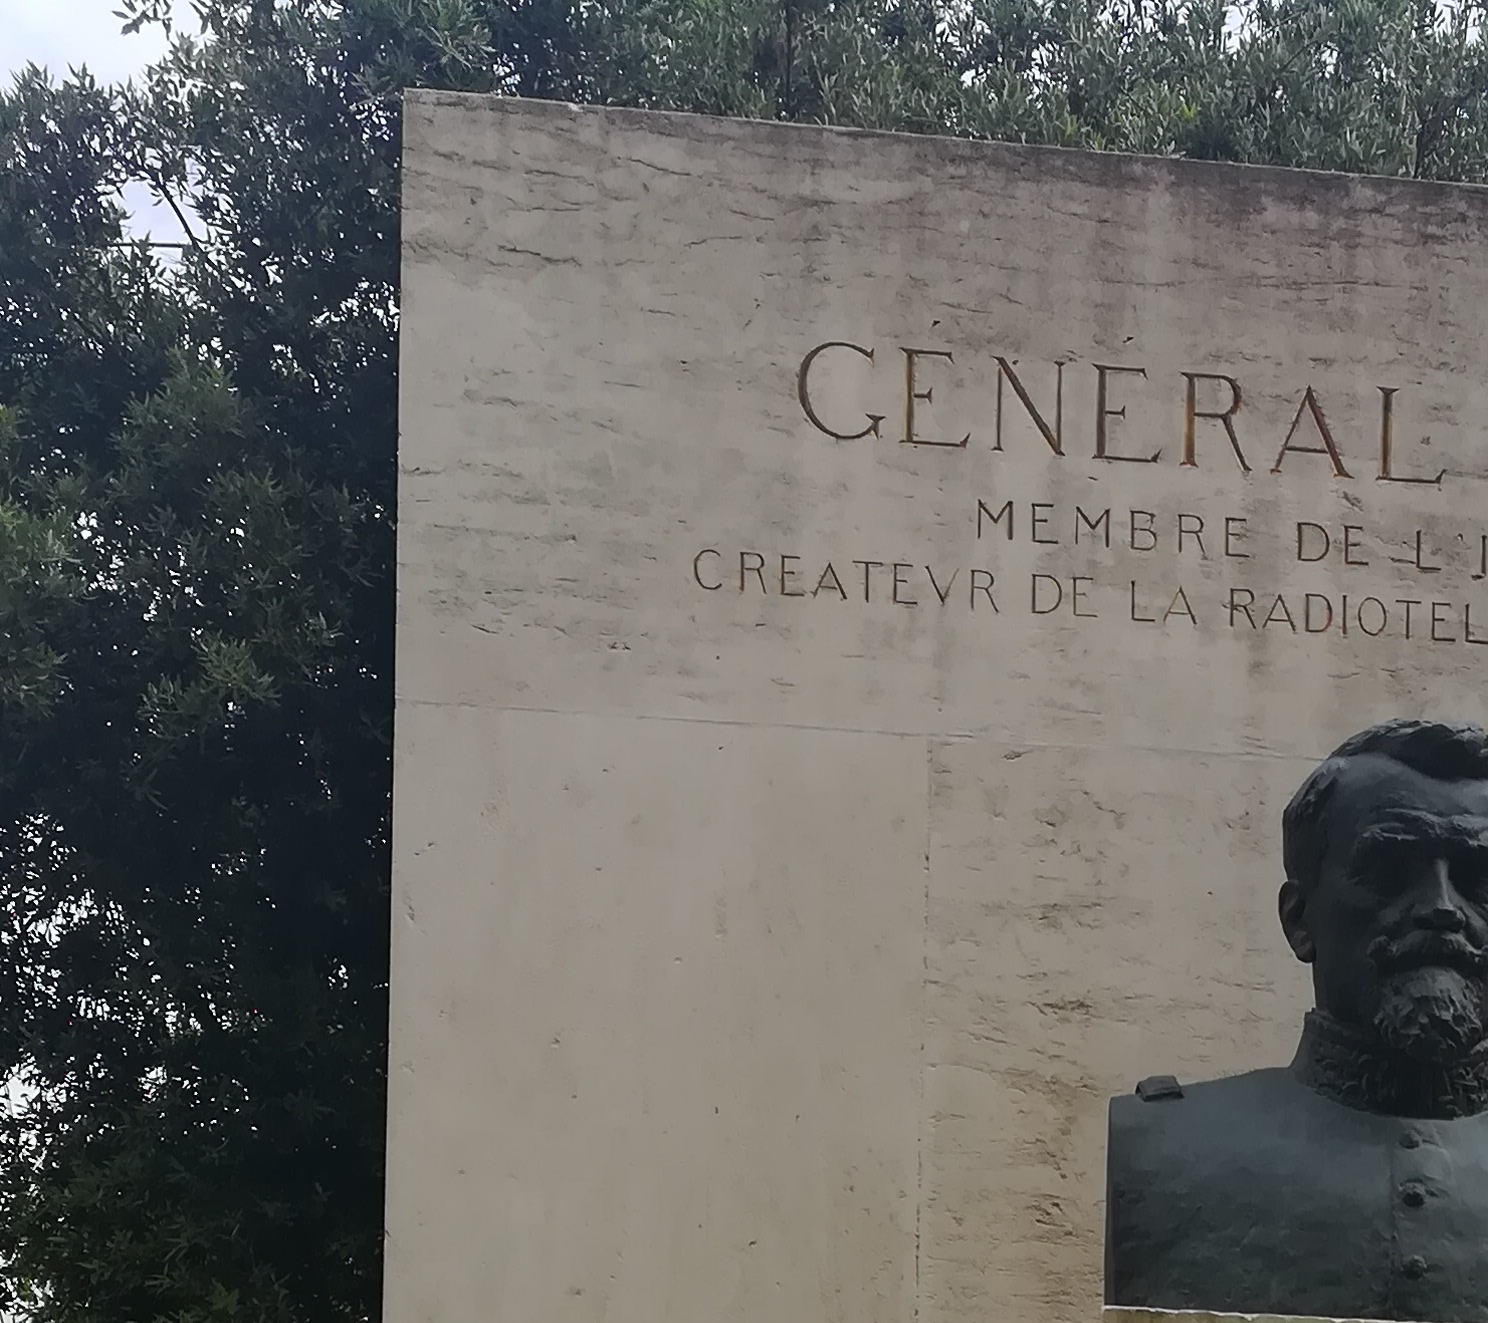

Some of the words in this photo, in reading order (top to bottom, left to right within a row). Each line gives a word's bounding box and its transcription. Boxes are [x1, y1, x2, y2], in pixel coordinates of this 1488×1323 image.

[976, 498, 1251, 558] MEMBRE
[1296, 521, 1370, 566] DE
[693, 548, 1000, 614] CREATEVR
[1030, 573, 1099, 618] DE
[1130, 579, 1198, 625] LA
